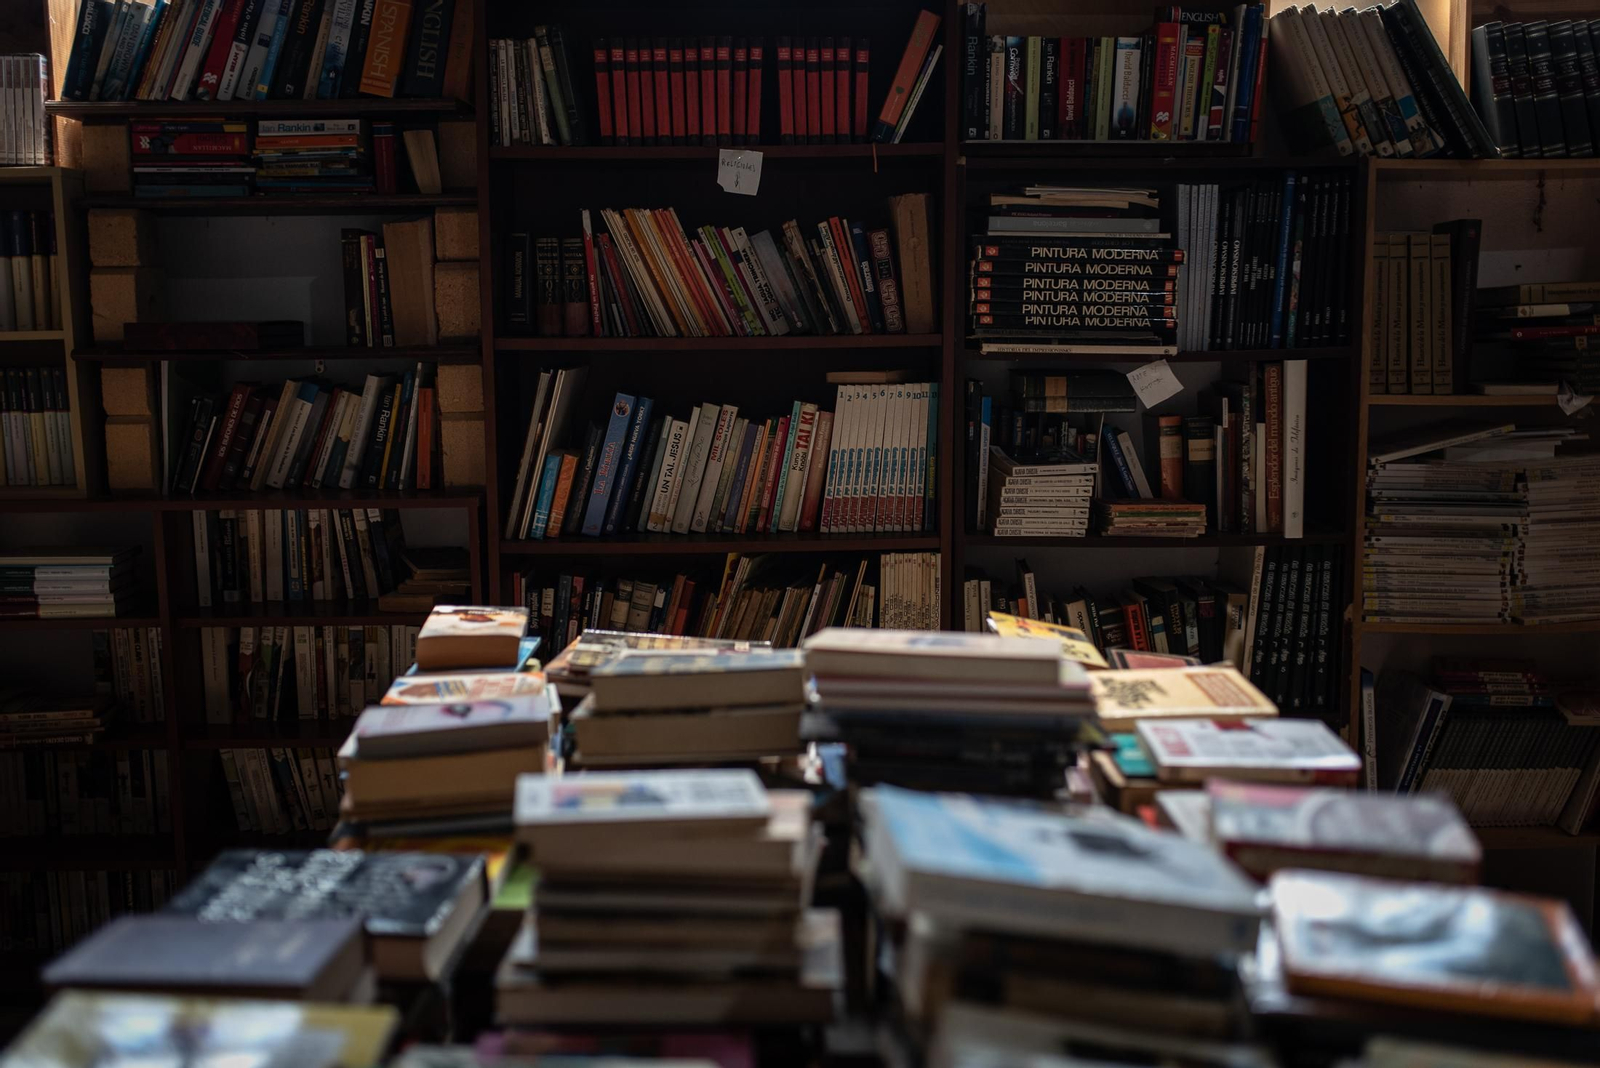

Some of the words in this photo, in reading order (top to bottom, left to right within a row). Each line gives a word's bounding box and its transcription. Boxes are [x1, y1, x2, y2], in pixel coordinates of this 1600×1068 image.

[1181, 12, 1219, 22] ENGLISH
[371, 4, 398, 78] SPANISH
[967, 36, 979, 76] Rankin
[1124, 51, 1133, 70] David
[1168, 46, 1176, 86] MACMILLAN
[1046, 56, 1054, 84] Rankin
[1067, 79, 1075, 104] Baldacci
[1123, 71, 1132, 100] Baldacci
[1186, 84, 1194, 118] THESAURUS
[1066, 107, 1074, 120] David
[262, 124, 275, 132] Ian
[278, 123, 311, 132] Rankin
[1033, 220, 1068, 228] Barcelona
[1032, 247, 1087, 258] PINTURA
[1092, 248, 1159, 260] MODERNA
[742, 248, 760, 284] TRINCHERA
[1025, 263, 1081, 274] PINTURA
[1086, 264, 1152, 275] MODERNA
[1219, 241, 1228, 295] IMPRESIONISMO
[1230, 240, 1240, 294] IMPRESIONISMO
[514, 276, 522, 298] MANUAL
[1024, 278, 1079, 290] PINTURA
[1083, 280, 1150, 290] MODERNA
[1023, 291, 1078, 302] PINTURA
[1083, 292, 1150, 303] MODERNA
[1022, 304, 1078, 314] PINTURA
[1082, 305, 1148, 316] MODERNA
[1025, 317, 1080, 326] PINTURA
[1084, 318, 1151, 327] MODERNA
[897, 390, 902, 398] 8
[1269, 368, 1280, 402] antiguo
[235, 394, 243, 408] DIOS
[383, 395, 392, 410] Ian
[376, 411, 390, 442] Rankin
[801, 410, 814, 426] KI
[1270, 404, 1280, 438] mundo
[631, 426, 640, 448] NUEVA
[668, 432, 682, 460] JESUS
[711, 446, 719, 462] MIL
[716, 409, 728, 444] SOLES
[717, 435, 728, 463] Dominique
[724, 410, 734, 435] Lapierre
[796, 428, 811, 450] TAI
[1269, 439, 1280, 452] del
[664, 460, 674, 479] TAL
[791, 452, 801, 471] Kuno
[660, 480, 669, 493] UN
[1268, 454, 1279, 499] Esplendor
